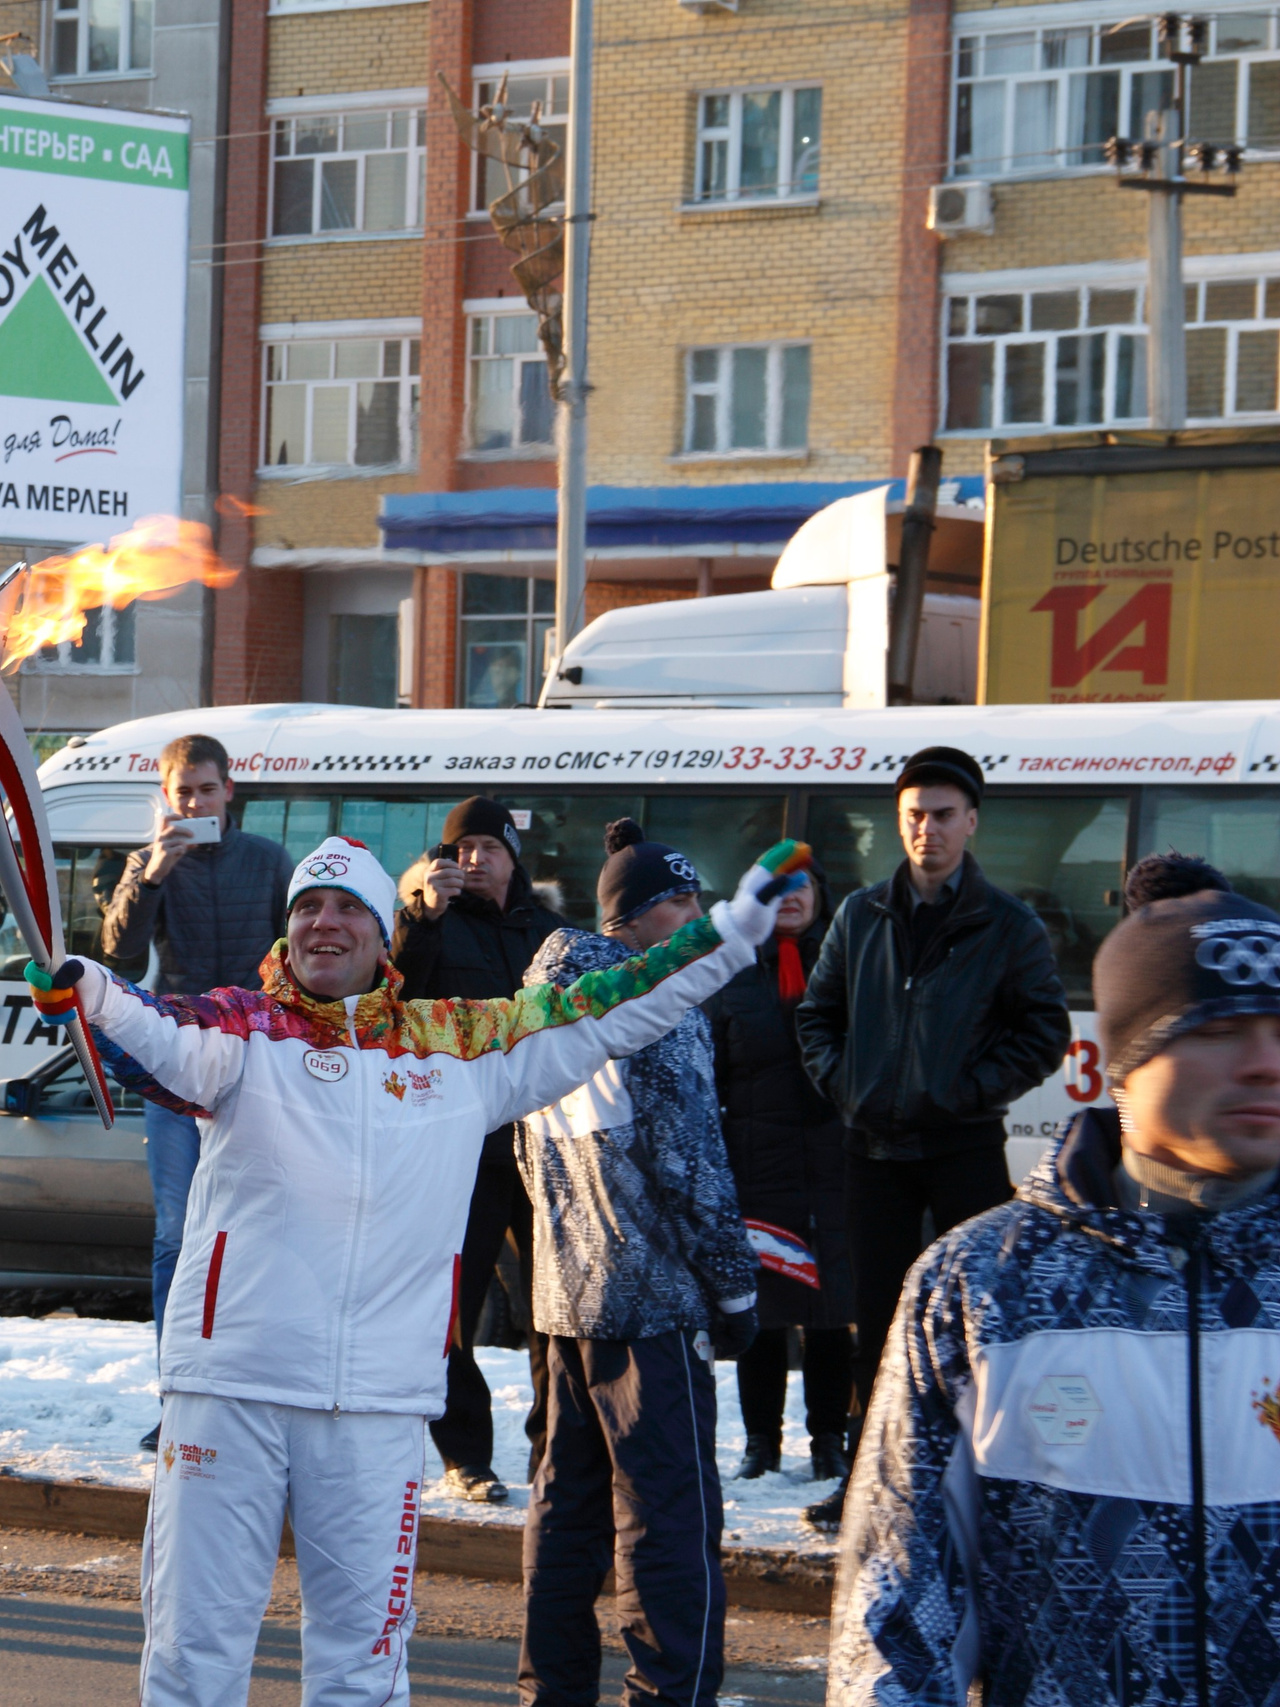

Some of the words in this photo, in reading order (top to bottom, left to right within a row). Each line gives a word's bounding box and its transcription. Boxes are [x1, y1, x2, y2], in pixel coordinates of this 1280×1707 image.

[120, 141, 173, 179] САД
[22, 203, 145, 401] MERLIN
[5, 430, 42, 463] для
[50, 415, 122, 447] Дома!
[27, 484, 128, 517] МЕРЛЕН
[1056, 531, 1201, 565] Deutsche
[1214, 530, 1280, 560] Post
[444, 755, 516, 770] заказ
[521, 755, 551, 770] по
[644, 749, 723, 769] (9129)
[723, 746, 867, 771] 33-33-33
[1017, 752, 1237, 776] таксинонстоп.рф
[326, 853, 351, 862] 2014
[310, 1058, 340, 1073] 069
[179, 1444, 217, 1458] sochi.ru
[182, 1452, 200, 1465] 2014
[371, 1565, 410, 1656] SOCHI
[397, 1481, 419, 1555] 2014
